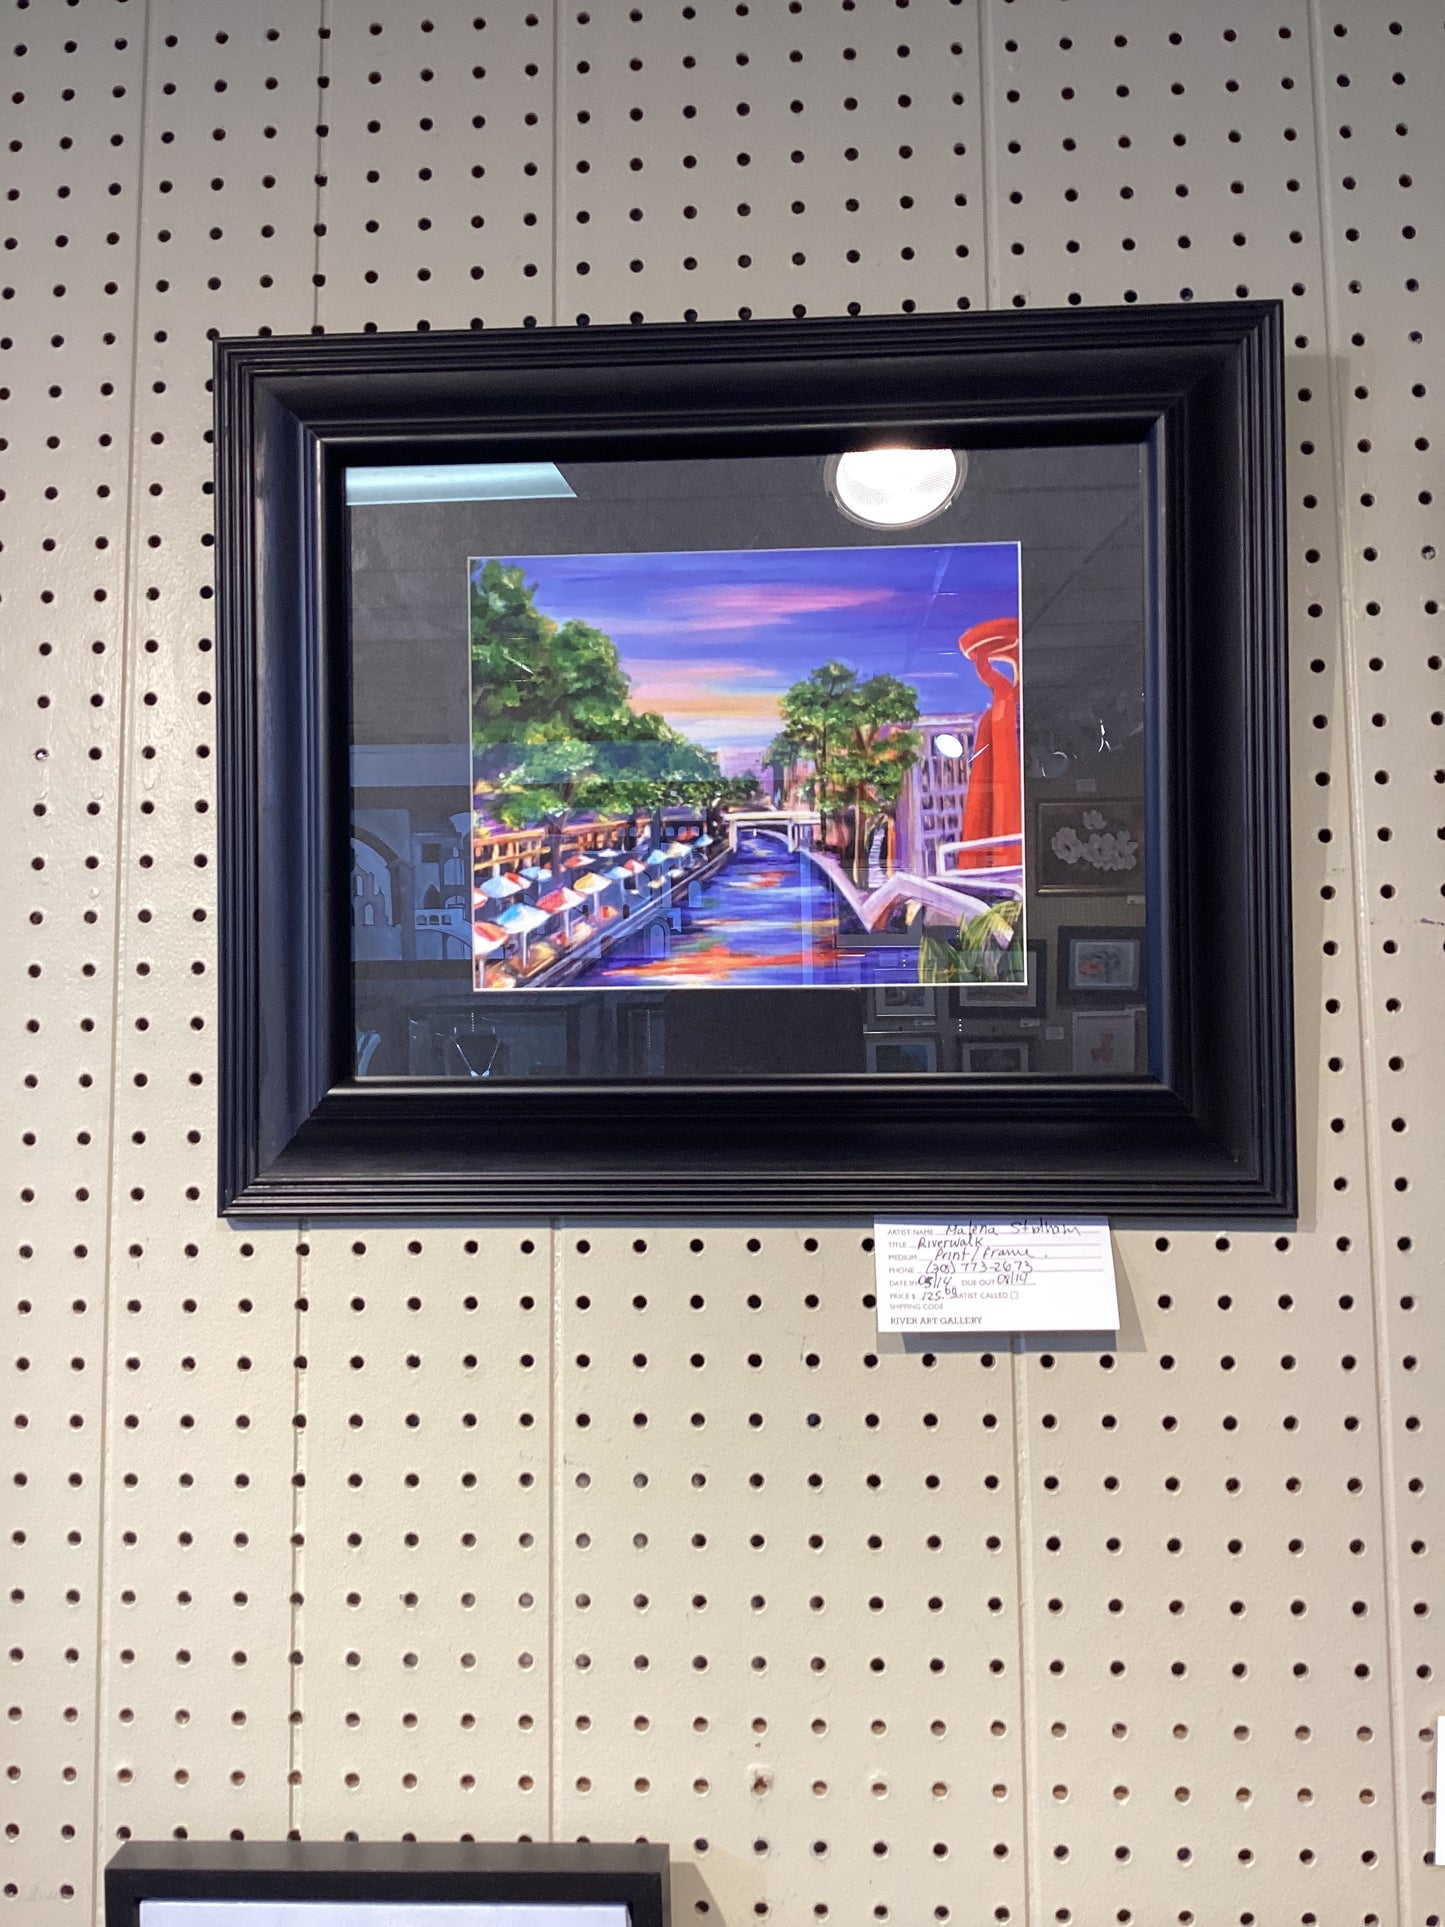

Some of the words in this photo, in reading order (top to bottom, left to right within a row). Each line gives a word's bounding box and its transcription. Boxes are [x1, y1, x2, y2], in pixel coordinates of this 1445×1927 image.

[887, 1228, 911, 1236] ARTIST
[912, 1228, 934, 1236] NAME
[887, 1241, 907, 1249] TITLE
[917, 1234, 985, 1250] Riverwalk
[889, 1279, 908, 1287] DATE
[961, 1279, 977, 1287] DUE
[979, 1279, 996, 1287] OUT
[889, 1292, 910, 1300] PRICE
[980, 1291, 1009, 1299] CALLED
[889, 1303, 921, 1311] SHIPPING
[922, 1303, 944, 1311] CODE
[890, 1316, 918, 1326] RIVER
[919, 1316, 938, 1325] ART
[939, 1316, 983, 1326] GALLERY
